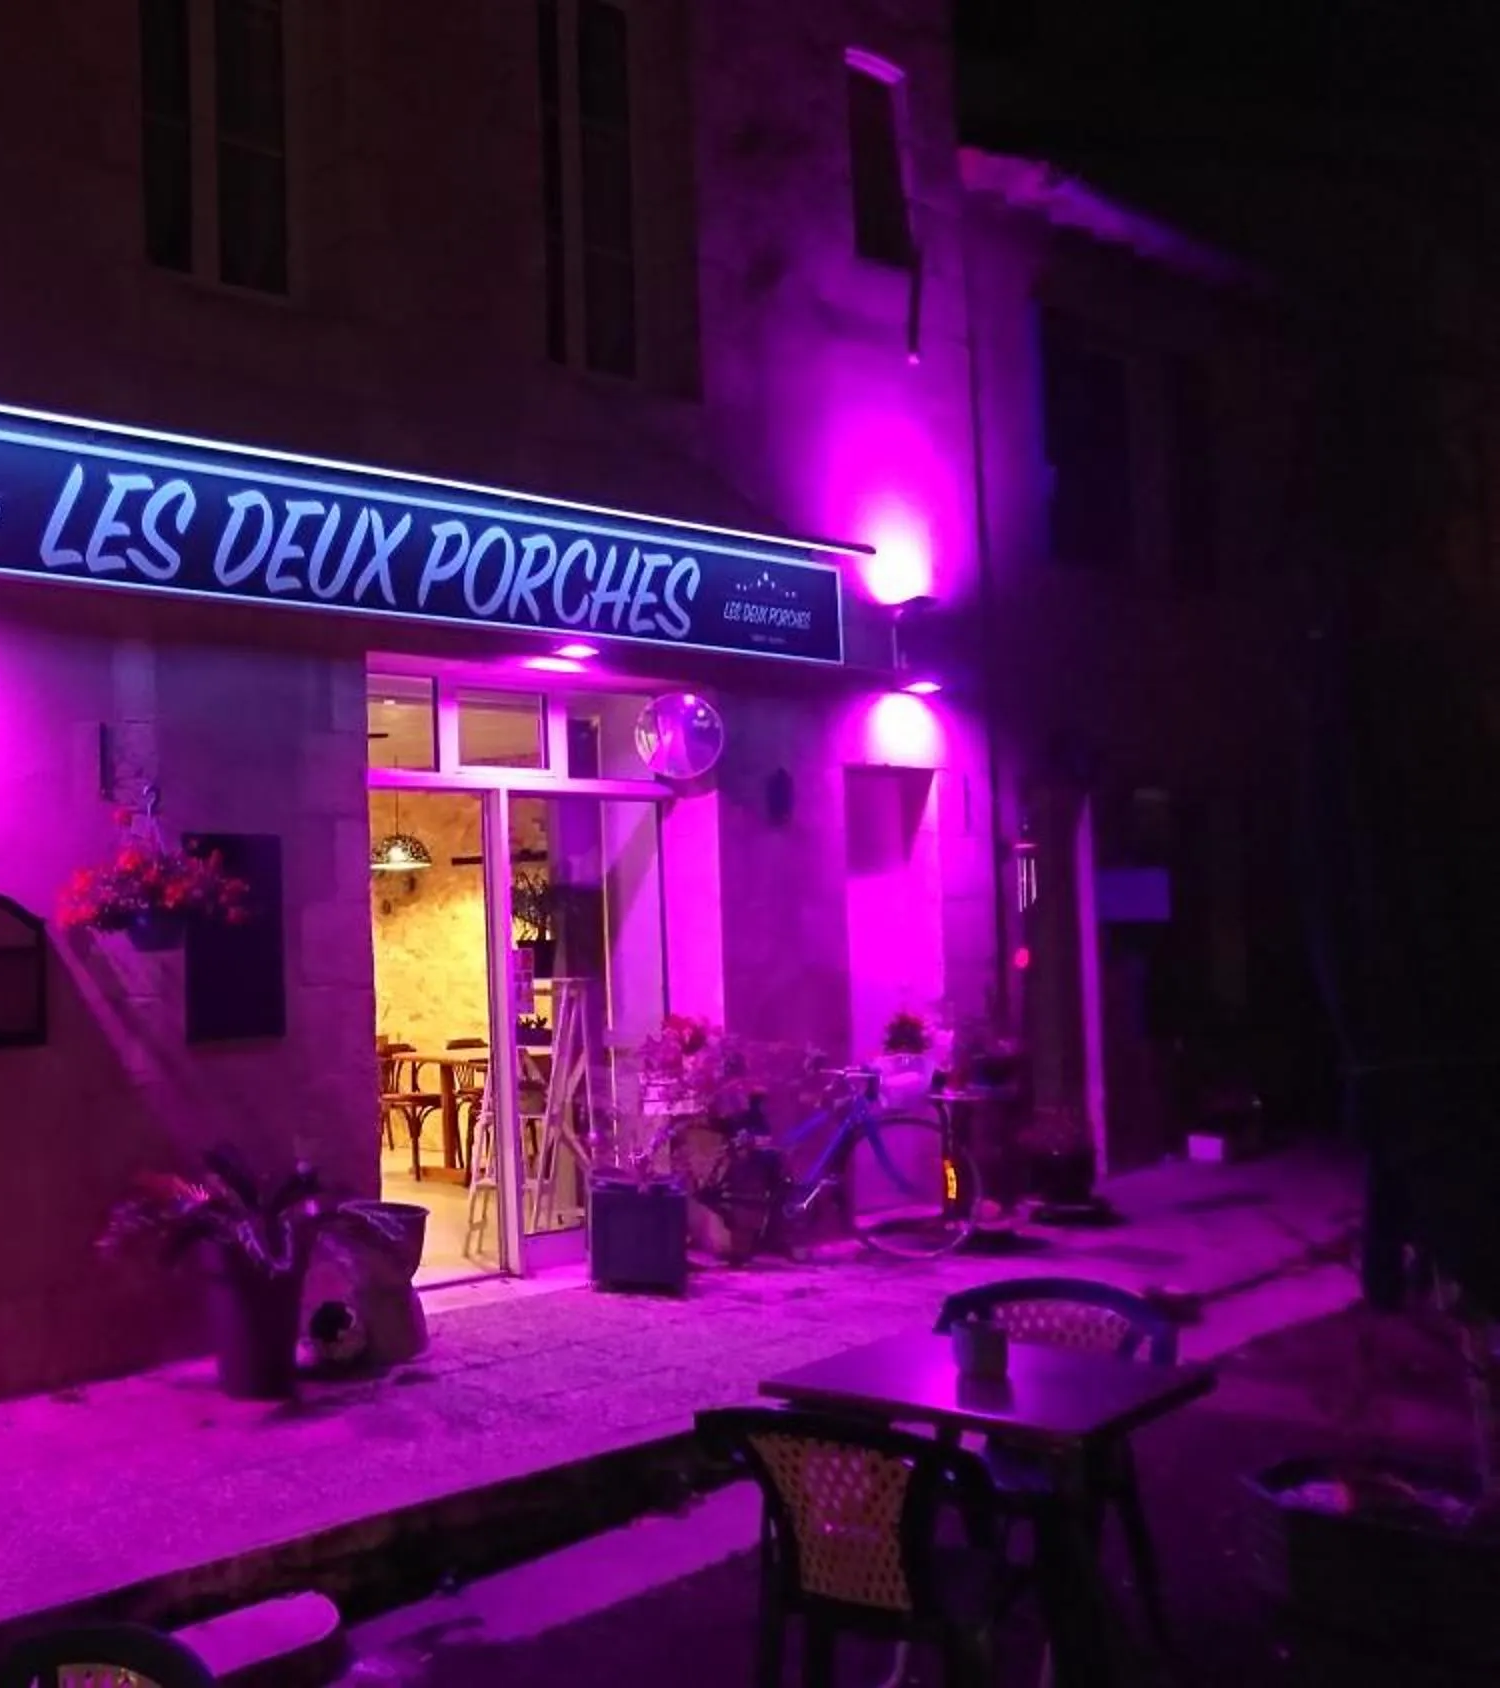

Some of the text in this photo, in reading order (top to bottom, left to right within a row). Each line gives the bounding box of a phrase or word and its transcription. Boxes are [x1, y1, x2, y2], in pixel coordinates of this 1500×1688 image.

[39, 462, 701, 639] LES DEUX PORCHES
